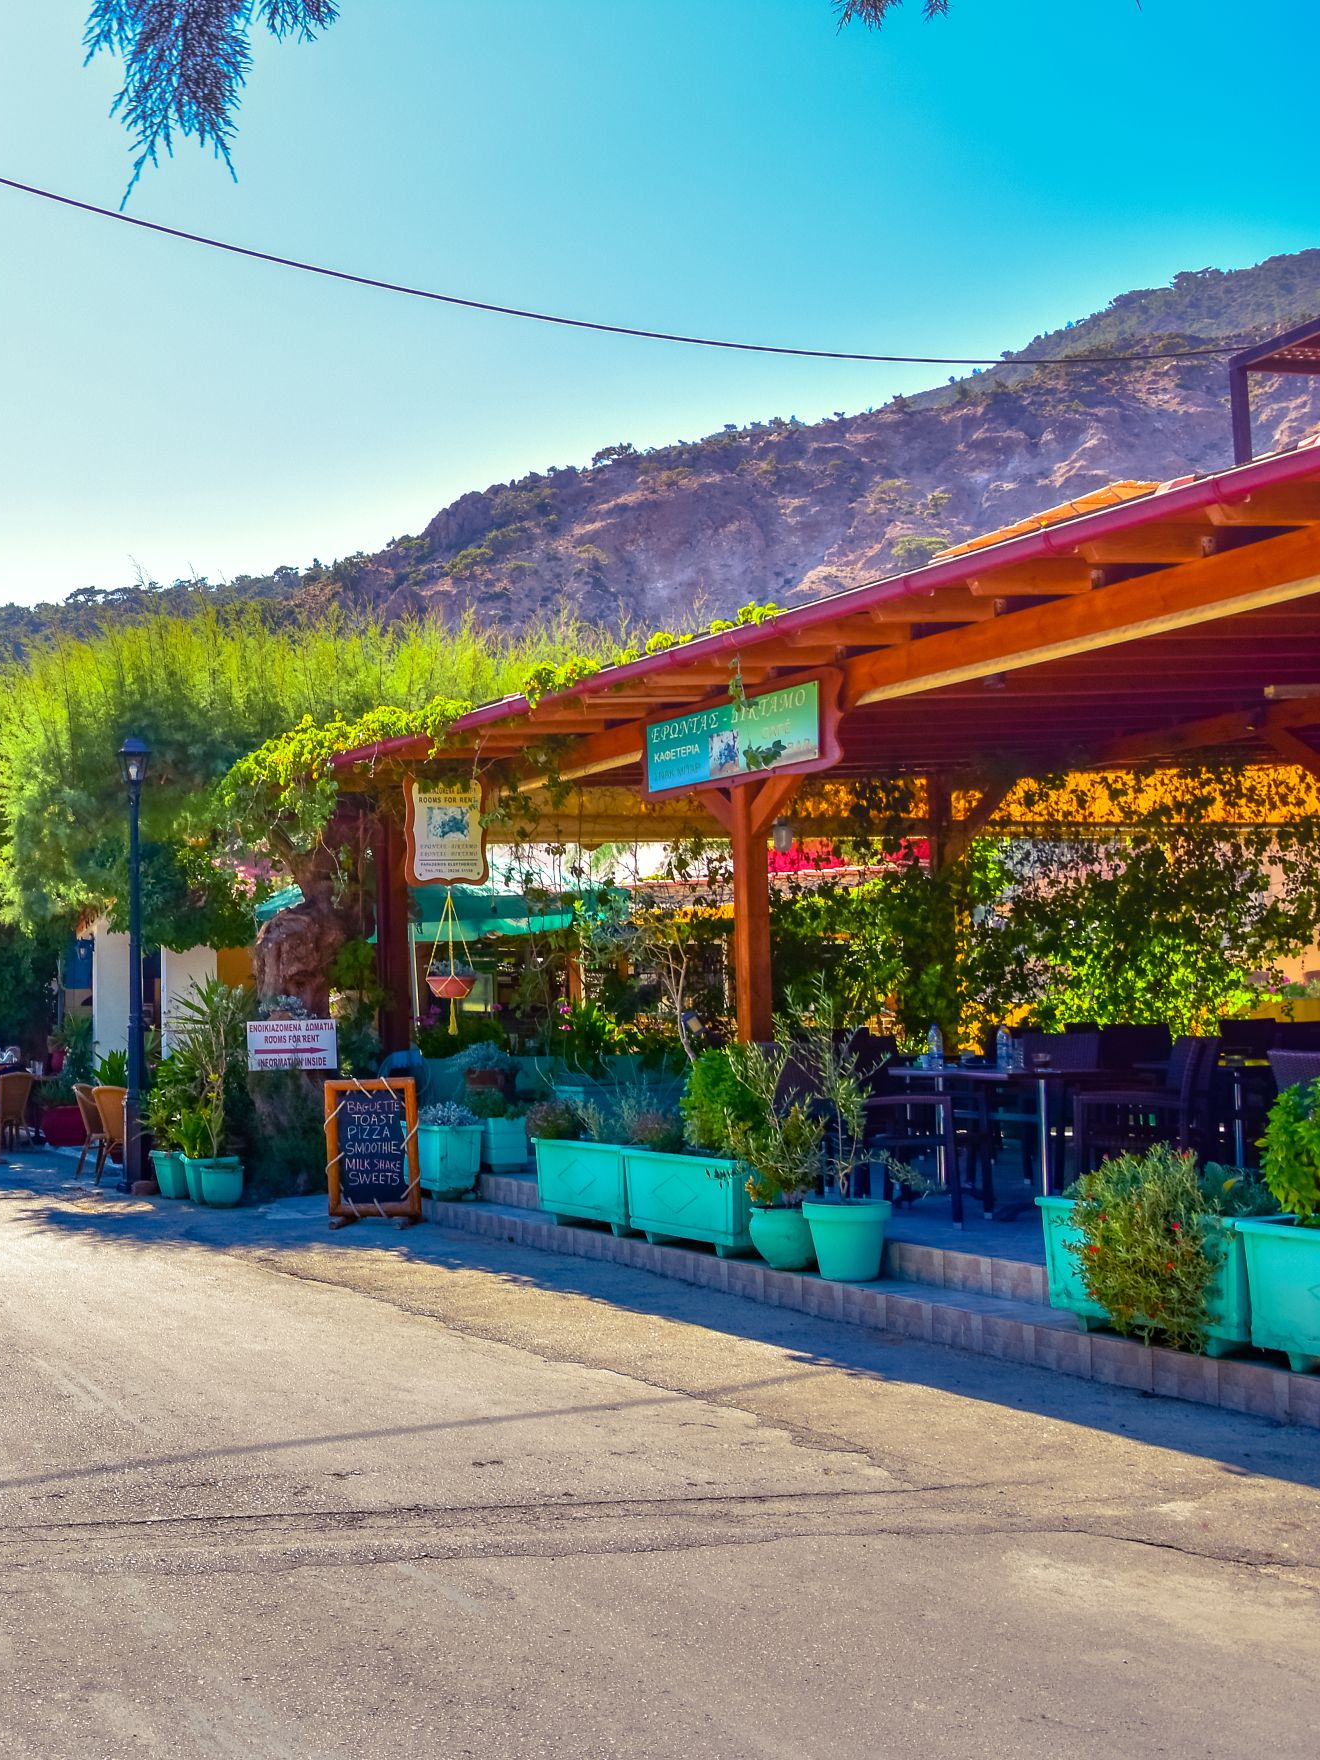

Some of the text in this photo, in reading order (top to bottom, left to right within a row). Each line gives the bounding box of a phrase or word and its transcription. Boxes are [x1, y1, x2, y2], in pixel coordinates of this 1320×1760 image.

[651, 712, 719, 743] ΕΡΩΝΤΑΣ
[654, 744, 700, 763] ΚΑΦΕΤΕΡΙΑ
[249, 1021, 335, 1033] ΕΝΟΙΚΙΑΖΟΜΕΝΑ ΔΩΜΑΤΙΑ
[264, 1034, 320, 1044] ROOMS FOR RENT
[257, 1056, 327, 1068] INFORMATION INSIDE
[346, 1100, 400, 1113] BAGUETTE
[352, 1114, 395, 1126] TOAST
[347, 1125, 391, 1139] PIZZA
[345, 1141, 401, 1156] SMOOTHIE
[345, 1158, 401, 1172] MILK SHAKE
[348, 1171, 400, 1186] SWEETS
